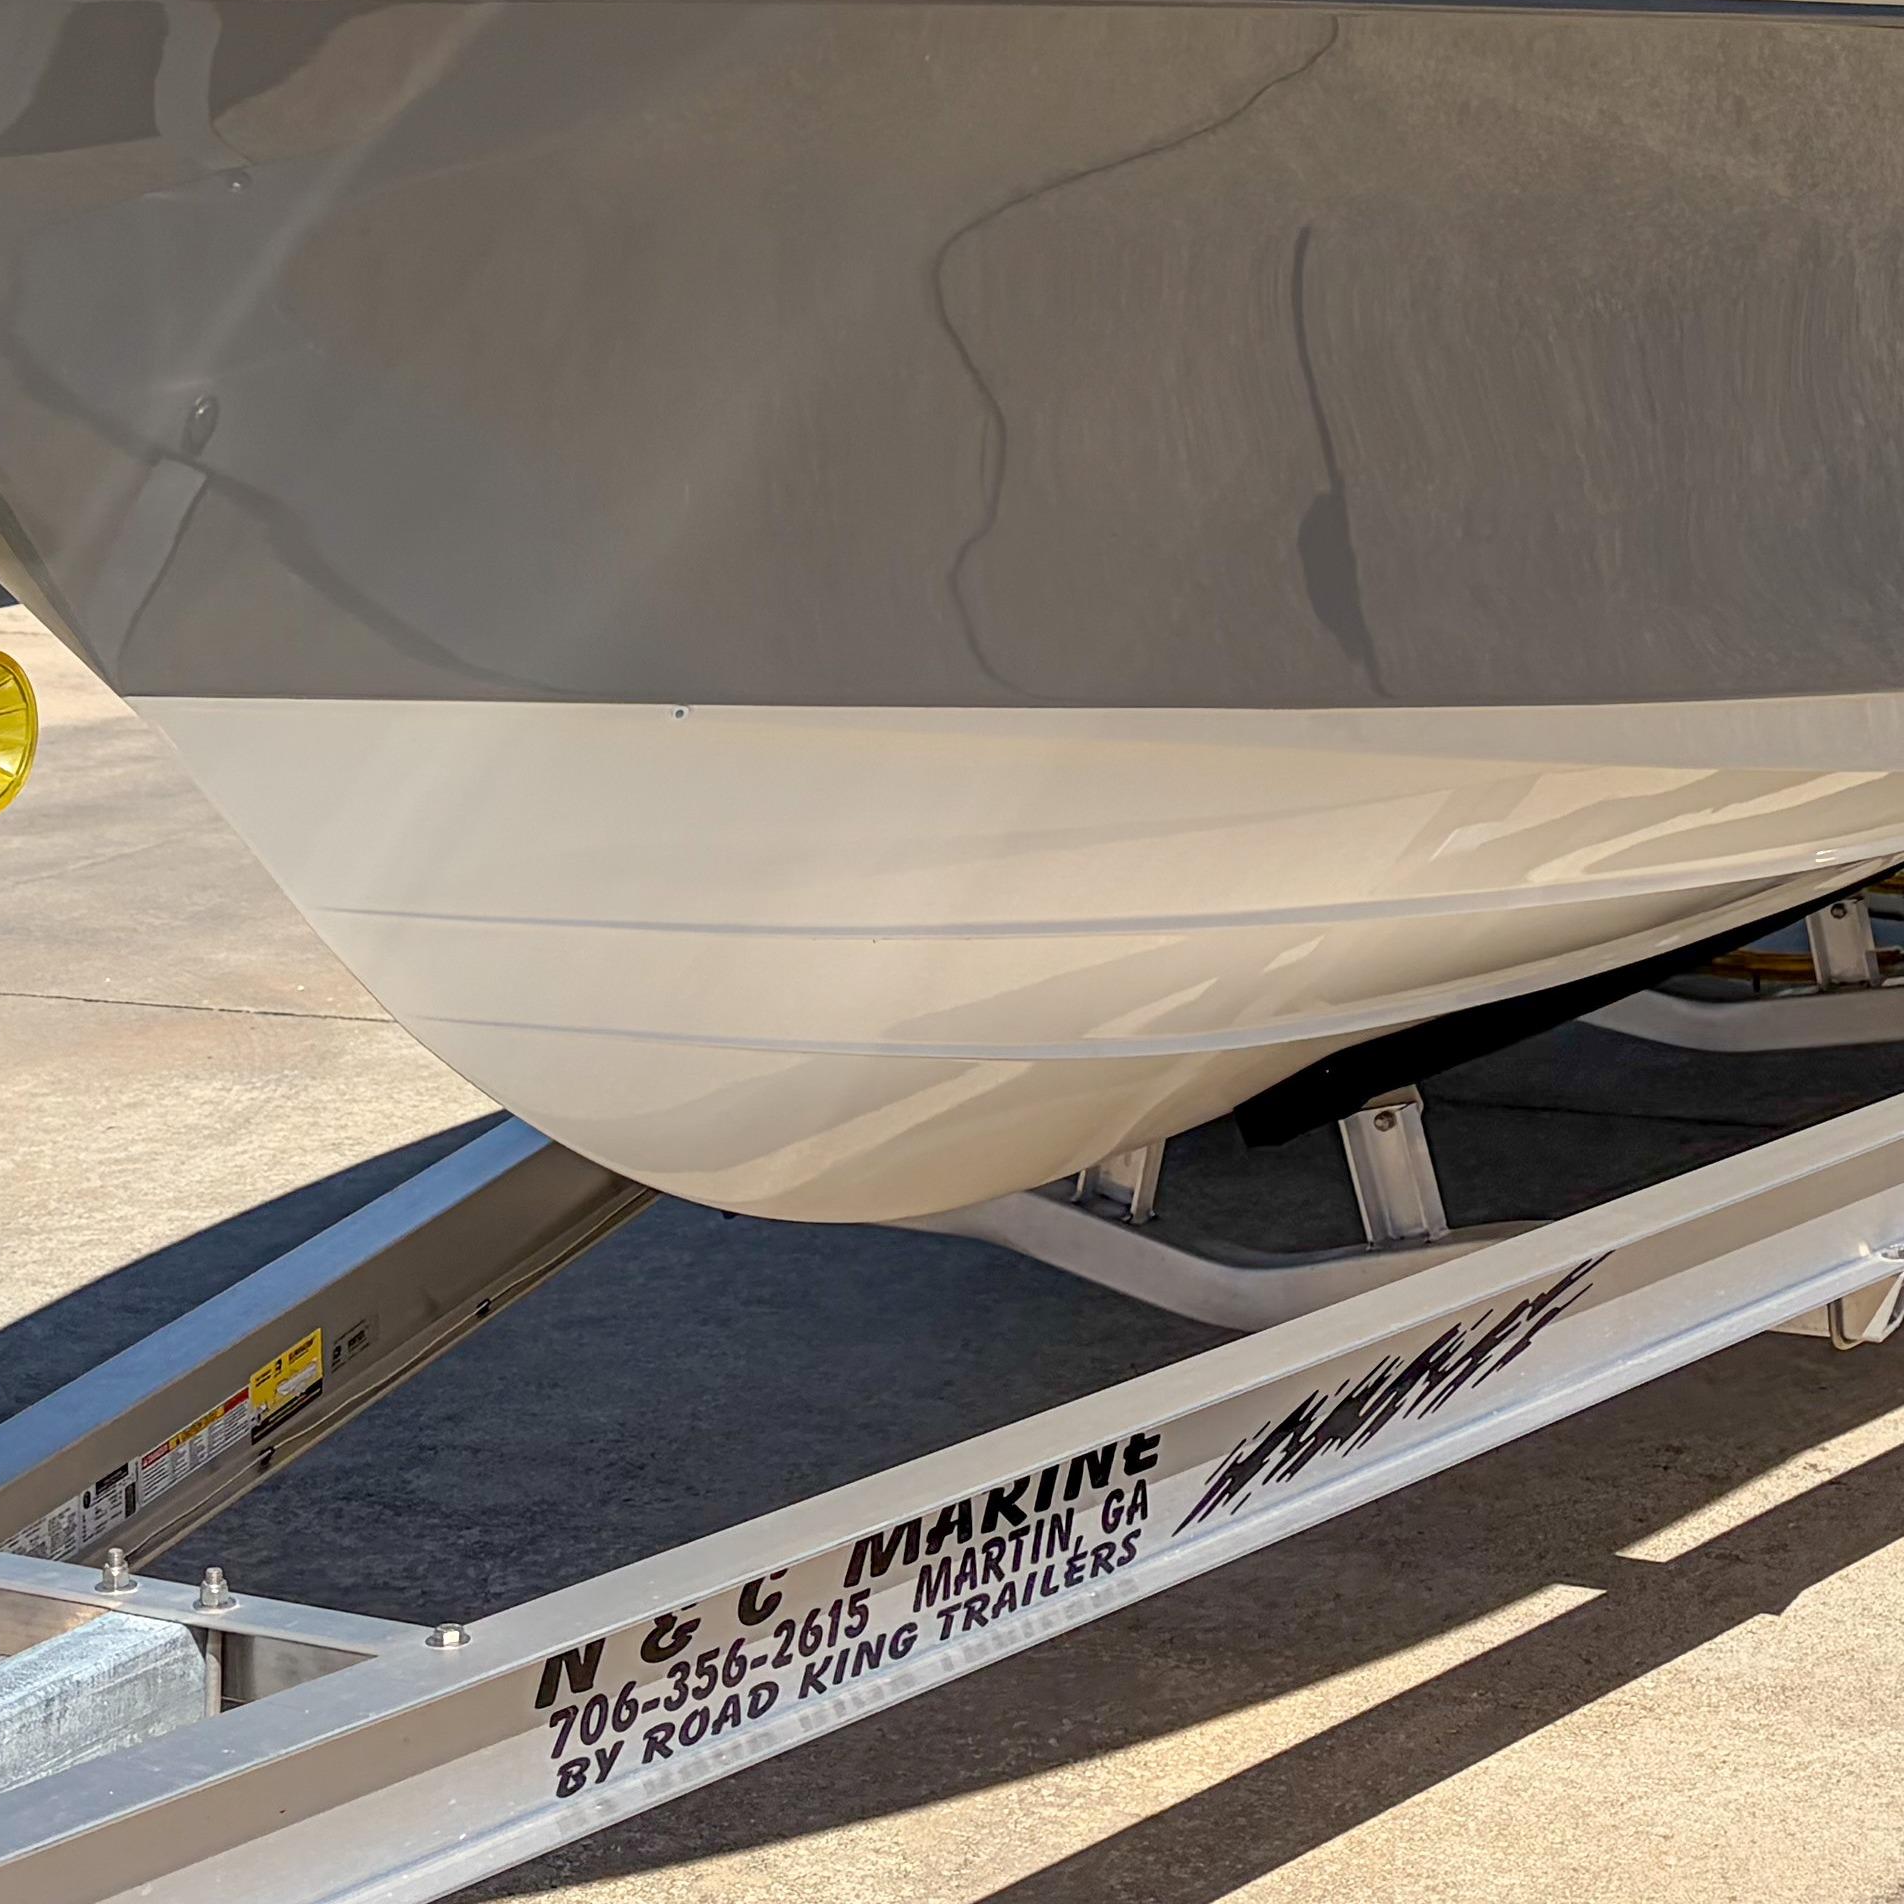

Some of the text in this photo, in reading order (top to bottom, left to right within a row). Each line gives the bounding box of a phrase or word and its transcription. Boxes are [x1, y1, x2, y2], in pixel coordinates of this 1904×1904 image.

[535, 1637, 607, 1709] N
[843, 1432, 1161, 1588] MARINE
[549, 1478, 1149, 1759] 706-356-2615 MARTIN, GA
[556, 1528, 1143, 1798] BY ROAD KING TRAILERS
